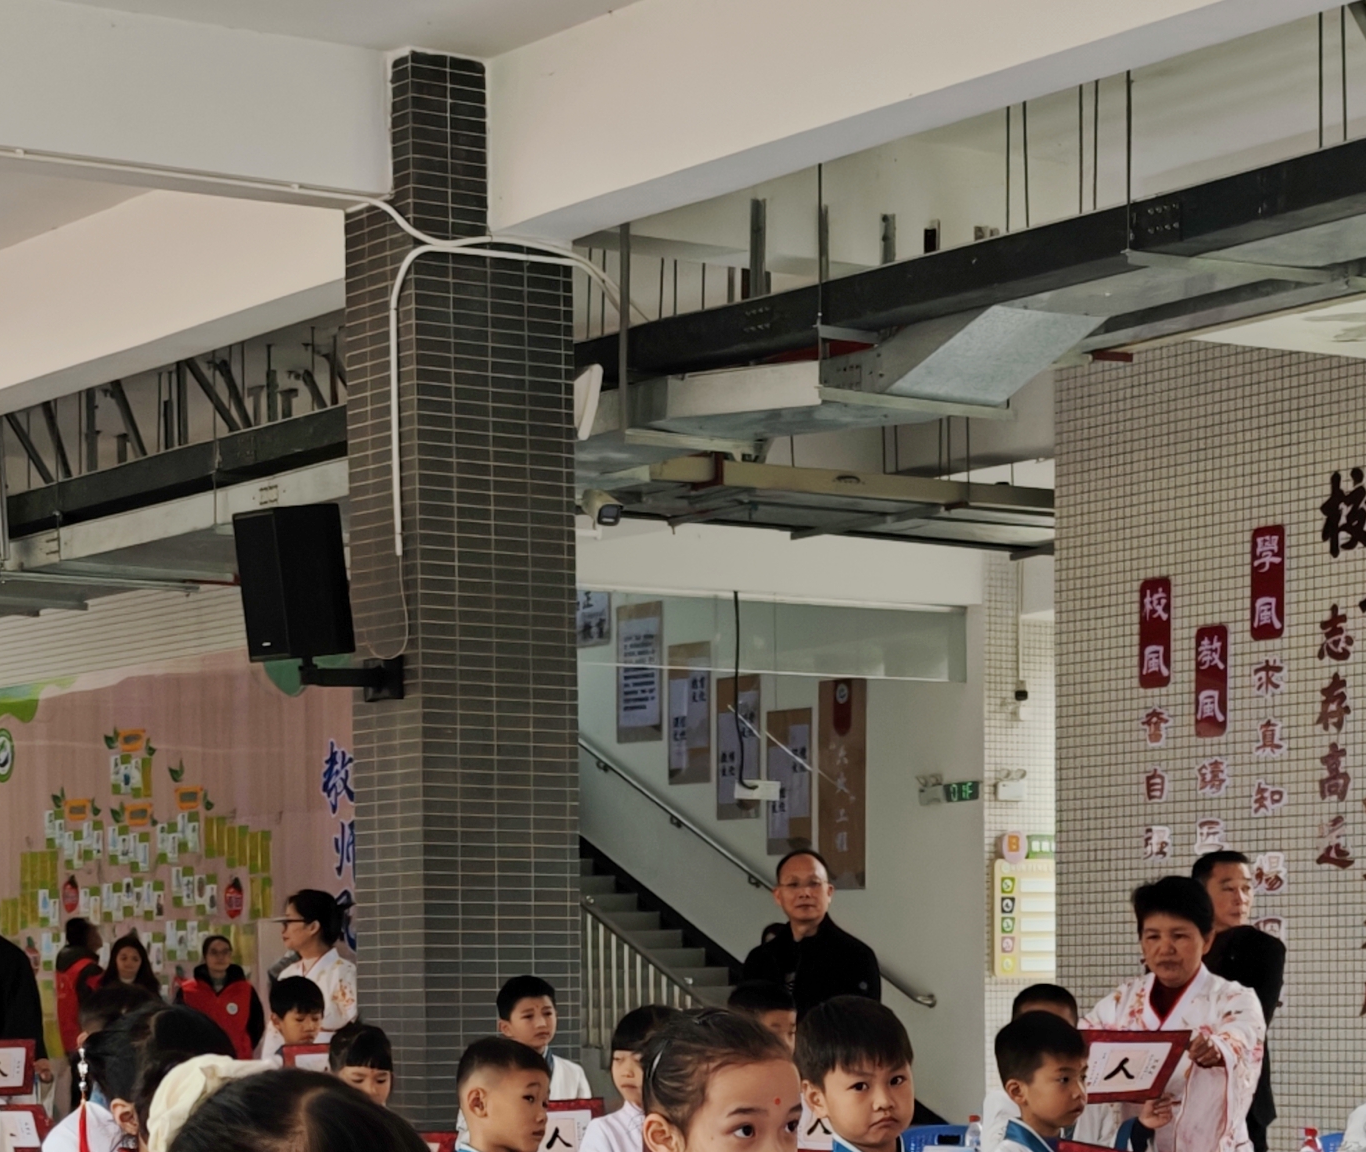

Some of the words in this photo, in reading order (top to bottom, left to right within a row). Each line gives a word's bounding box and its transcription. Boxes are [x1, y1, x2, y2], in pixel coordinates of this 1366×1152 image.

[1253, 536, 1282, 630] 學風
[1142, 588, 1169, 677] 校風
[1197, 634, 1225, 723] 教風
[1104, 1058, 1134, 1080] 人
[546, 1127, 572, 1149] 人
